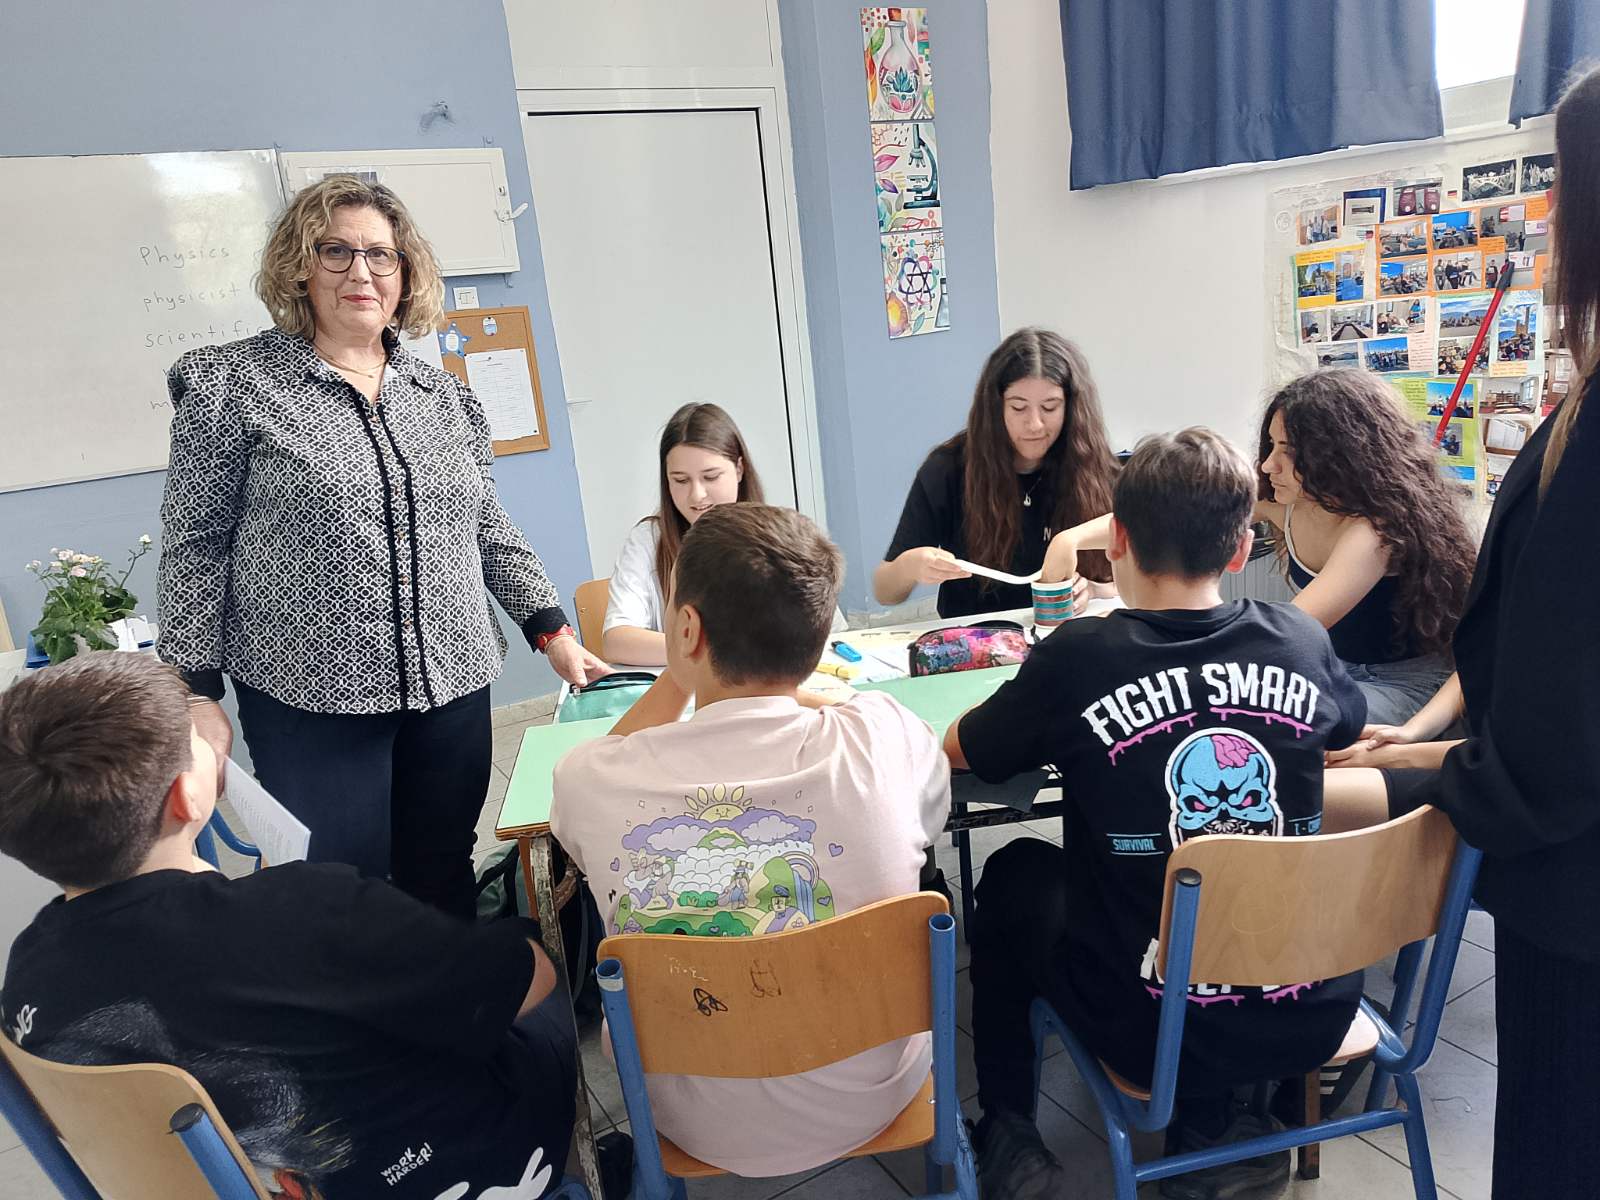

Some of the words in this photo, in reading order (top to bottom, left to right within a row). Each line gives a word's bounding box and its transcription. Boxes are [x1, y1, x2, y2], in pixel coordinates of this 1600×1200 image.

[139, 245, 230, 268] Physics
[143, 282, 241, 312] physicist
[1081, 666, 1190, 746] FIGHT
[1200, 662, 1320, 724] SMART
[1112, 838, 1156, 851] SURVIVAL
[380, 1147, 416, 1177] WORK
[386, 1142, 433, 1186] HARDER!
